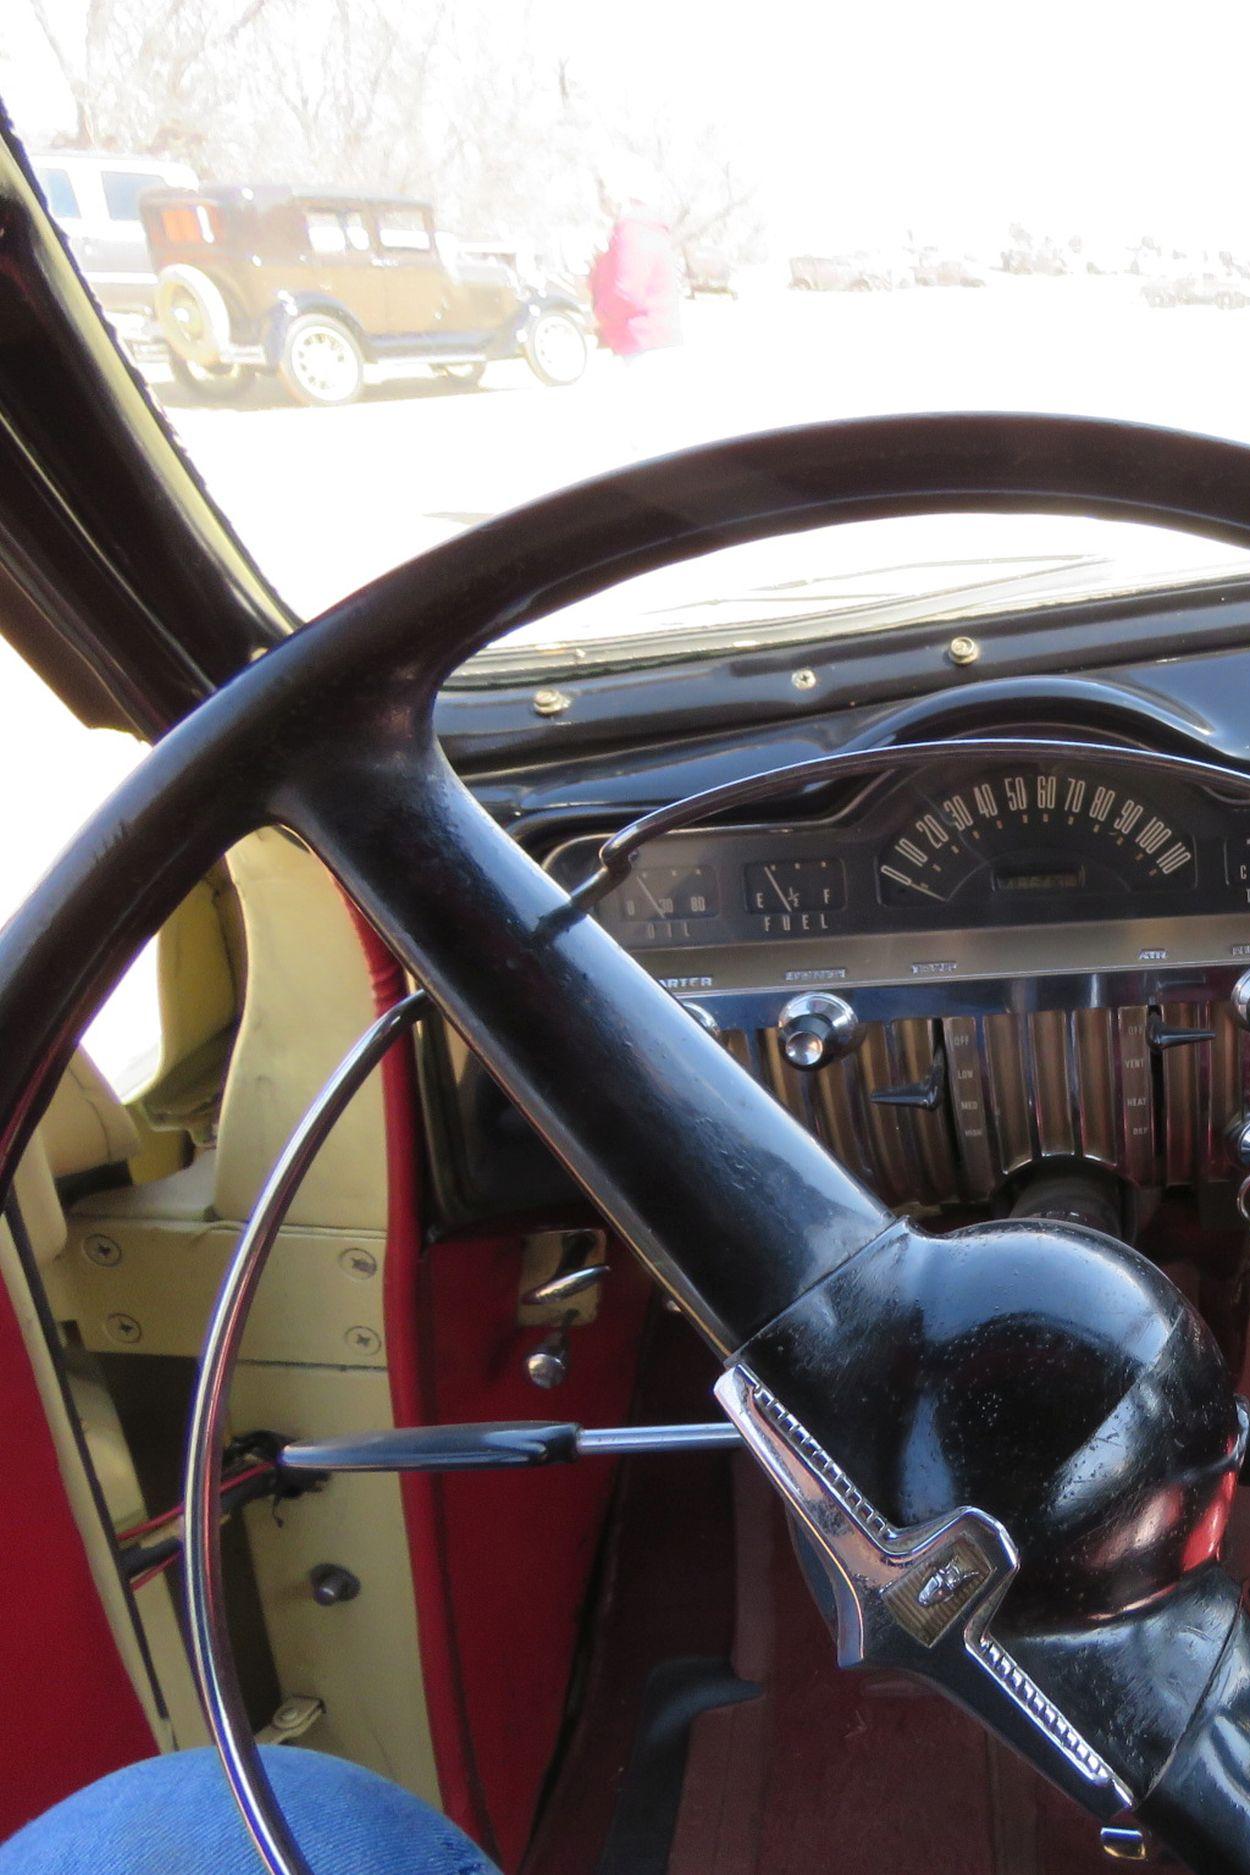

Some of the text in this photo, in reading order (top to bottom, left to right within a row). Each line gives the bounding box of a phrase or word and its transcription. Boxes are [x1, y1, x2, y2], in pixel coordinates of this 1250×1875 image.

[894, 838, 928, 867] 10
[915, 814, 949, 849] 20
[943, 795, 973, 831] 30
[973, 783, 998, 818] 40
[1004, 777, 1027, 811] 50
[1037, 776, 1057, 809] 60
[1064, 777, 1086, 813] 70
[1089, 786, 1115, 822] 80
[1113, 800, 1144, 834] 90
[1135, 816, 1172, 854] 100
[1156, 842, 1191, 875] 110
[756, 892, 764, 909] E
[823, 888, 830, 904] F
[764, 913, 828, 932] FUEL
[658, 977, 713, 988] ARTER
